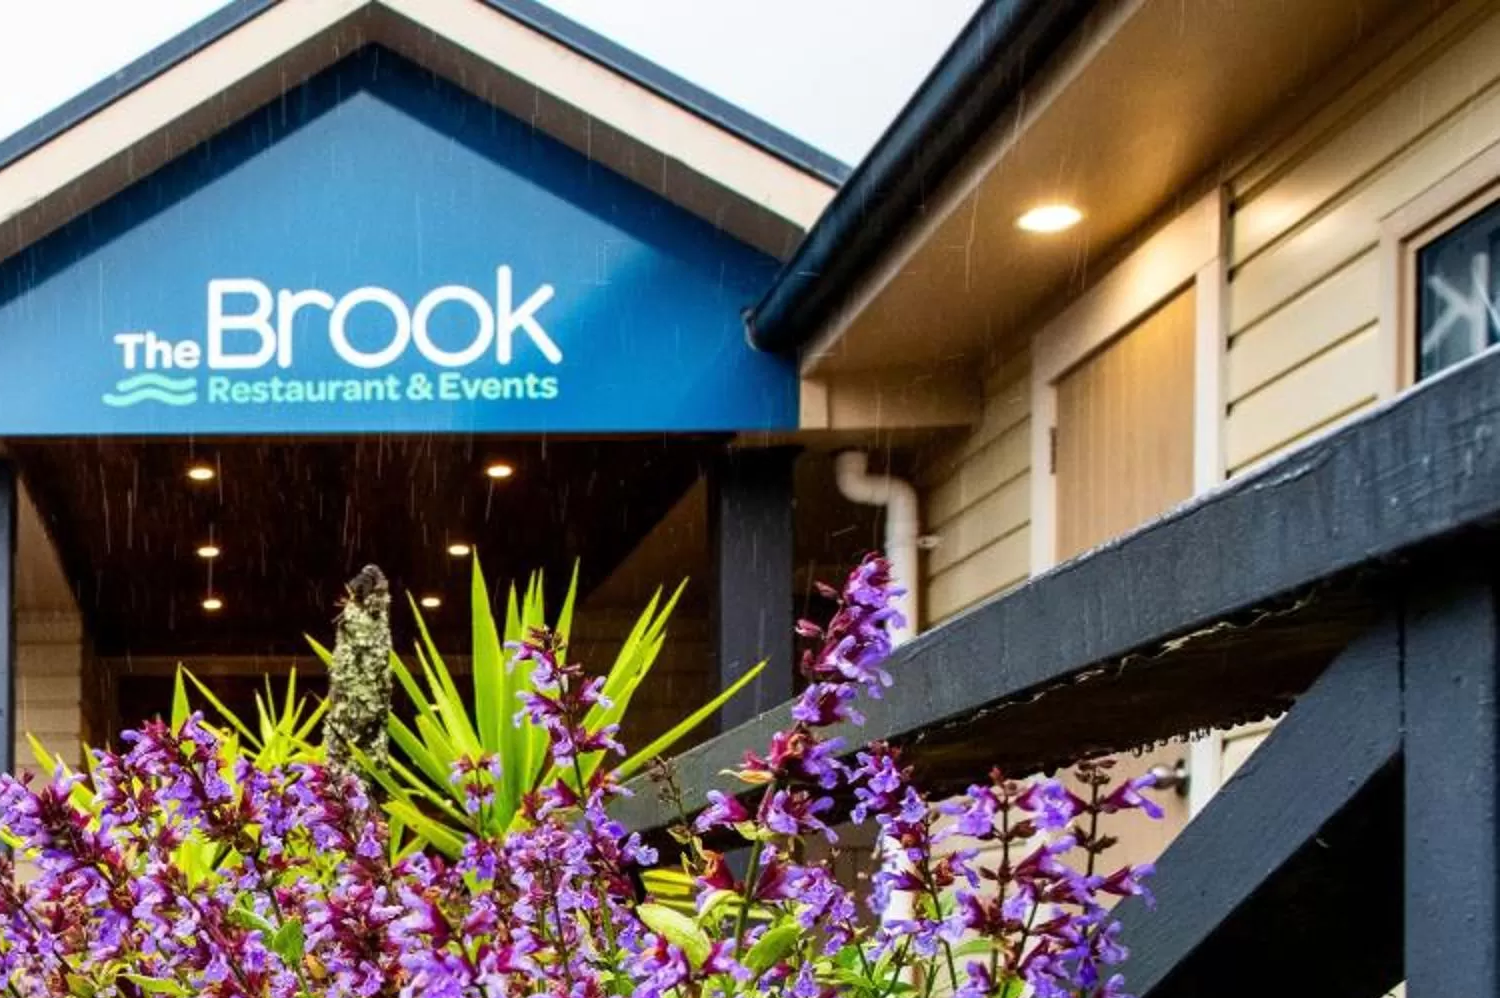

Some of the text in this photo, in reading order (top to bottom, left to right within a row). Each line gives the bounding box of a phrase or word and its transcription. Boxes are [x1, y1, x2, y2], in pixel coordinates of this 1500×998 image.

[114, 264, 563, 370] The Brook
[208, 372, 559, 405] Restaurant & Events
